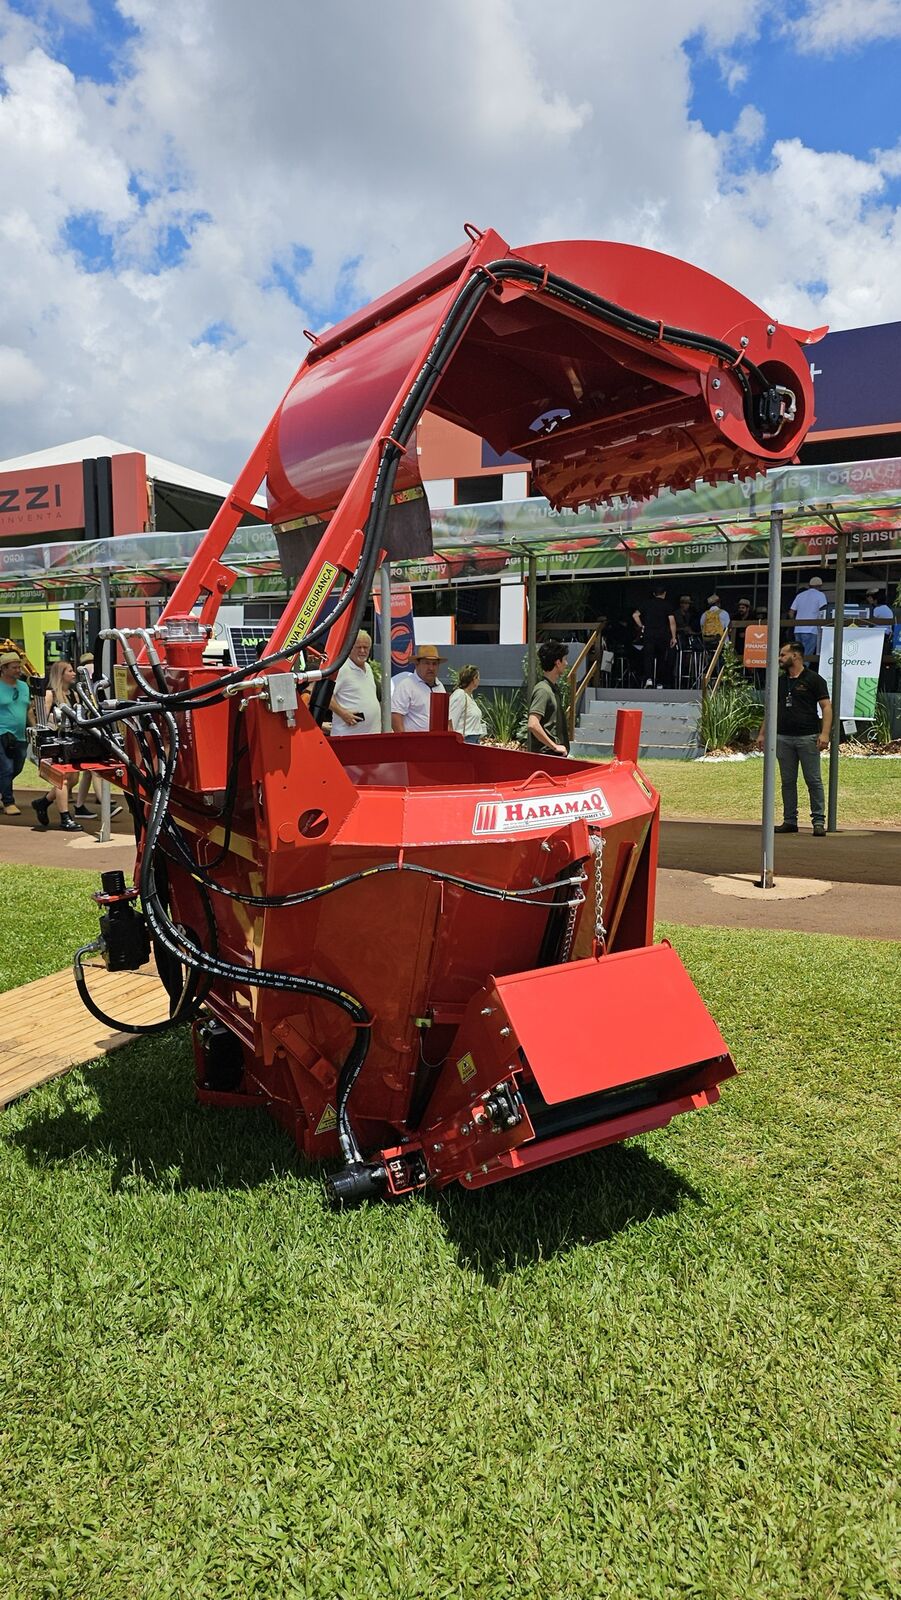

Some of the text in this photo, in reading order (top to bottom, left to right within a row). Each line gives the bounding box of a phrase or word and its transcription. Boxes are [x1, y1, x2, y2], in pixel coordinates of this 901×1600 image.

[852, 530, 901, 543] sansu
[646, 547, 674, 557] AGRO
[297, 618, 307, 631] DE
[304, 568, 333, 618] SEGURANÇA
[827, 657, 872, 667] Copere+
[504, 793, 604, 822] HARAMAQ
